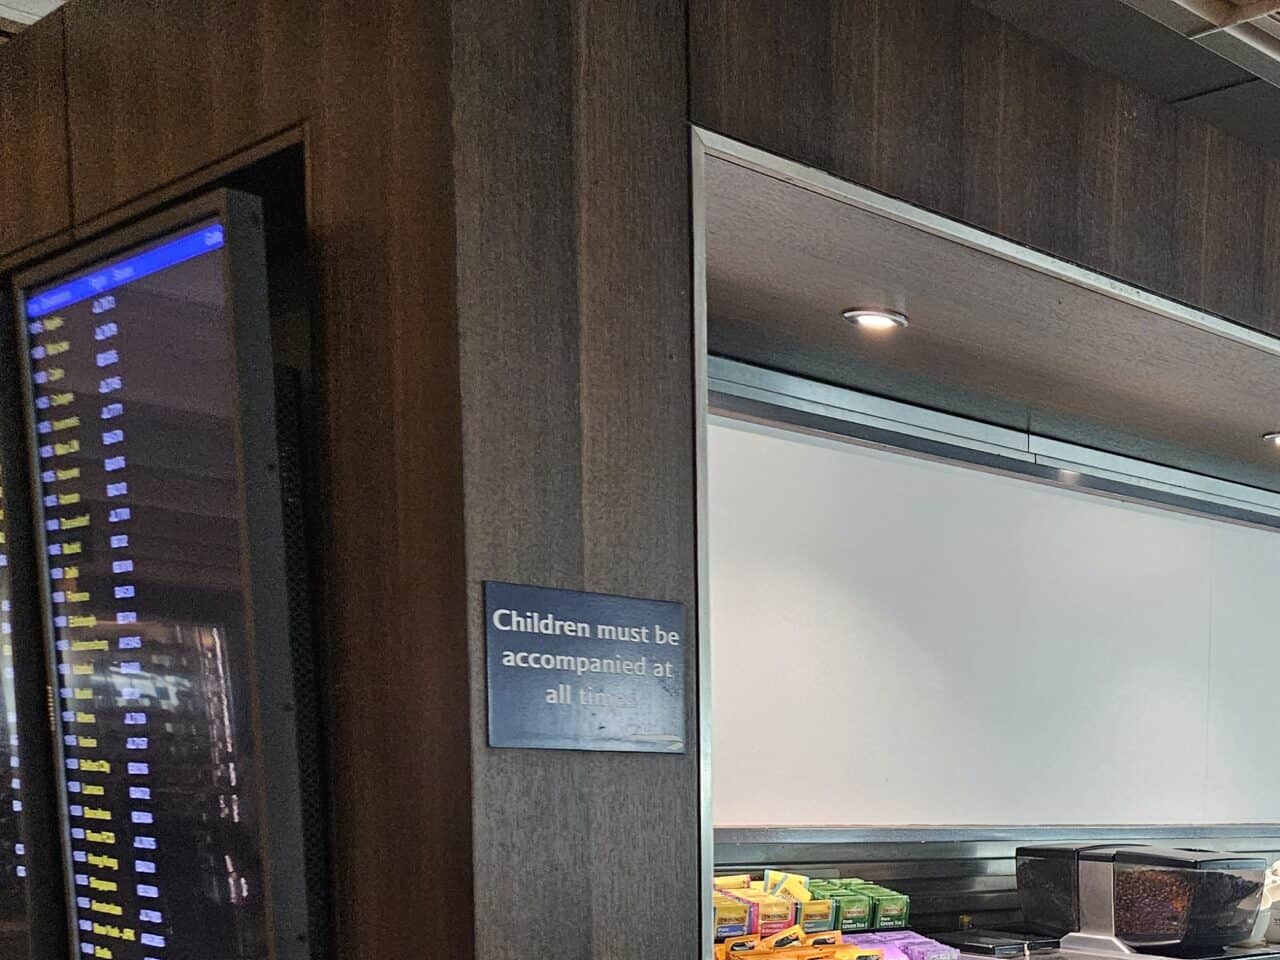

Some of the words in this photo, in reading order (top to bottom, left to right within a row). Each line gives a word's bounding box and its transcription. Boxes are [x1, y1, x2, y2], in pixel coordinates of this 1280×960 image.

[492, 608, 591, 638] Children
[597, 624, 649, 643] must
[655, 625, 680, 646] be
[502, 650, 646, 676] accompanied
[653, 661, 673, 678] at
[545, 684, 572, 705] all
